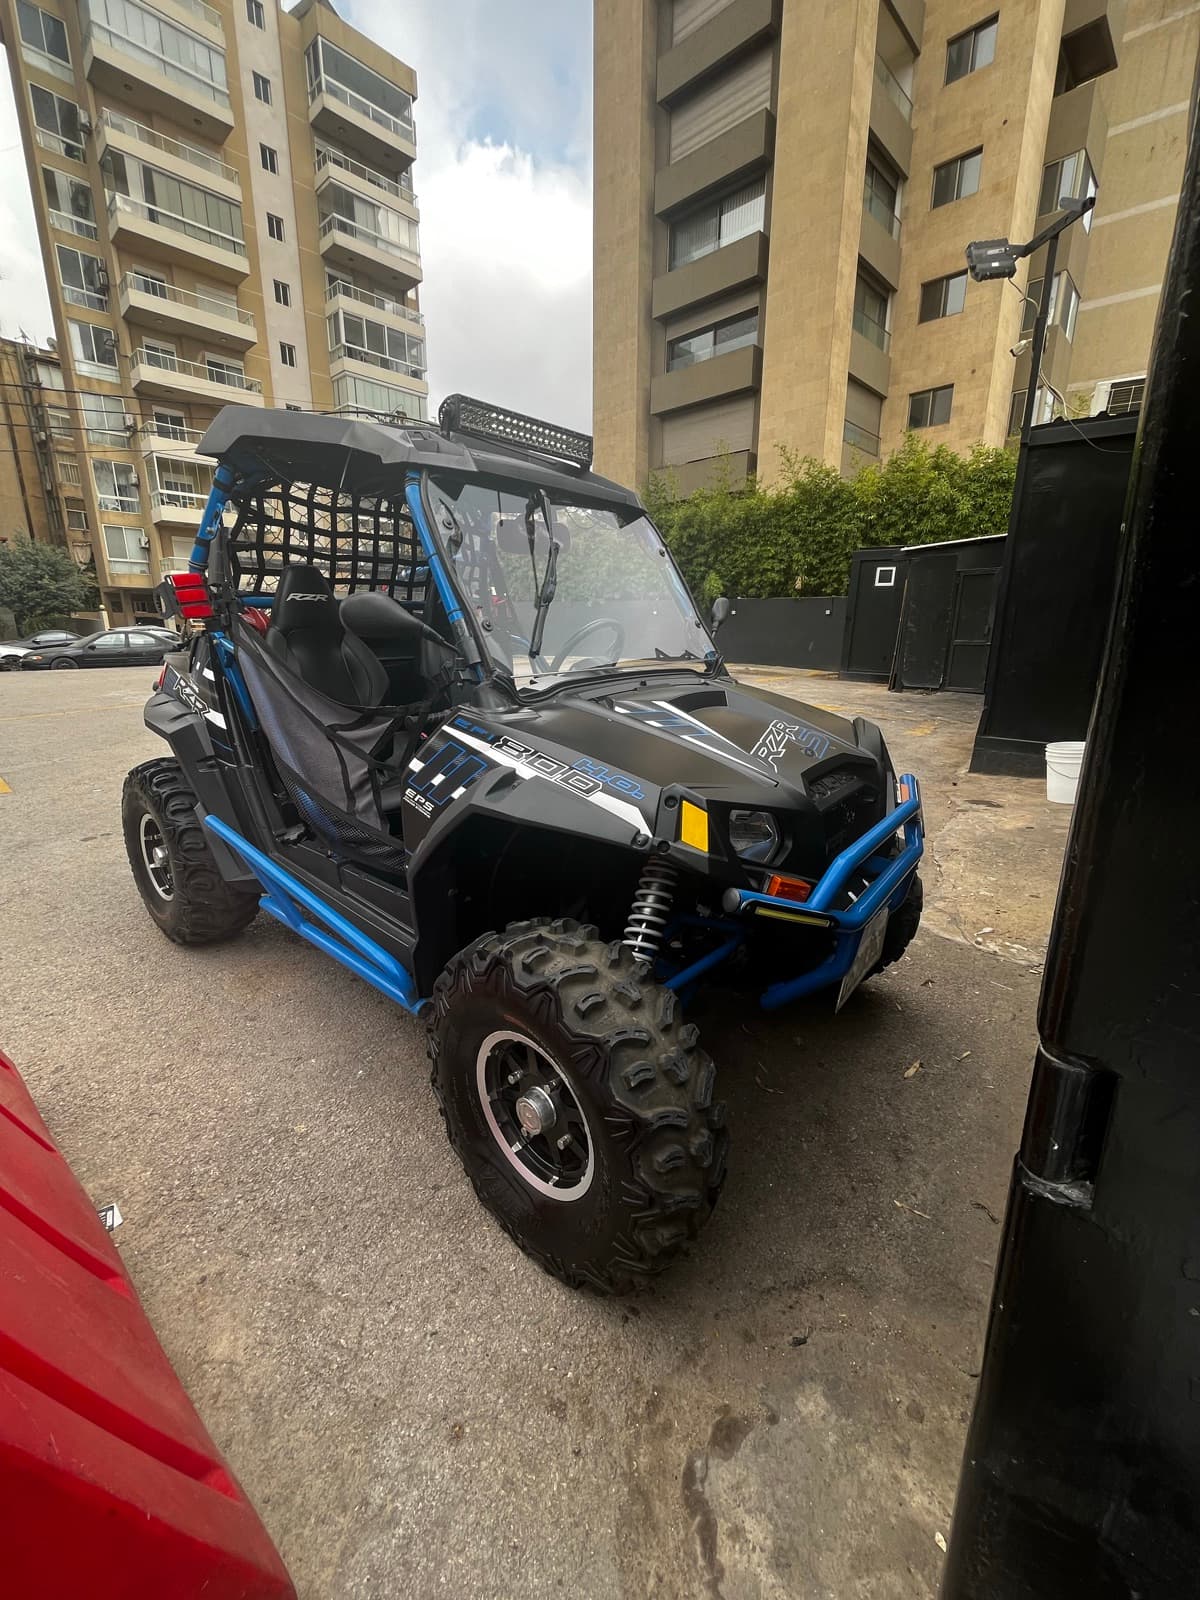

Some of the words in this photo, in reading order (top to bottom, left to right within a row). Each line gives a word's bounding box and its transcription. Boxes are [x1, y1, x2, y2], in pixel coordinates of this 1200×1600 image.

[285, 592, 330, 602] RZR
[750, 719, 800, 774] RZR
[490, 735, 603, 798] 800
[404, 788, 435, 812] EPS
